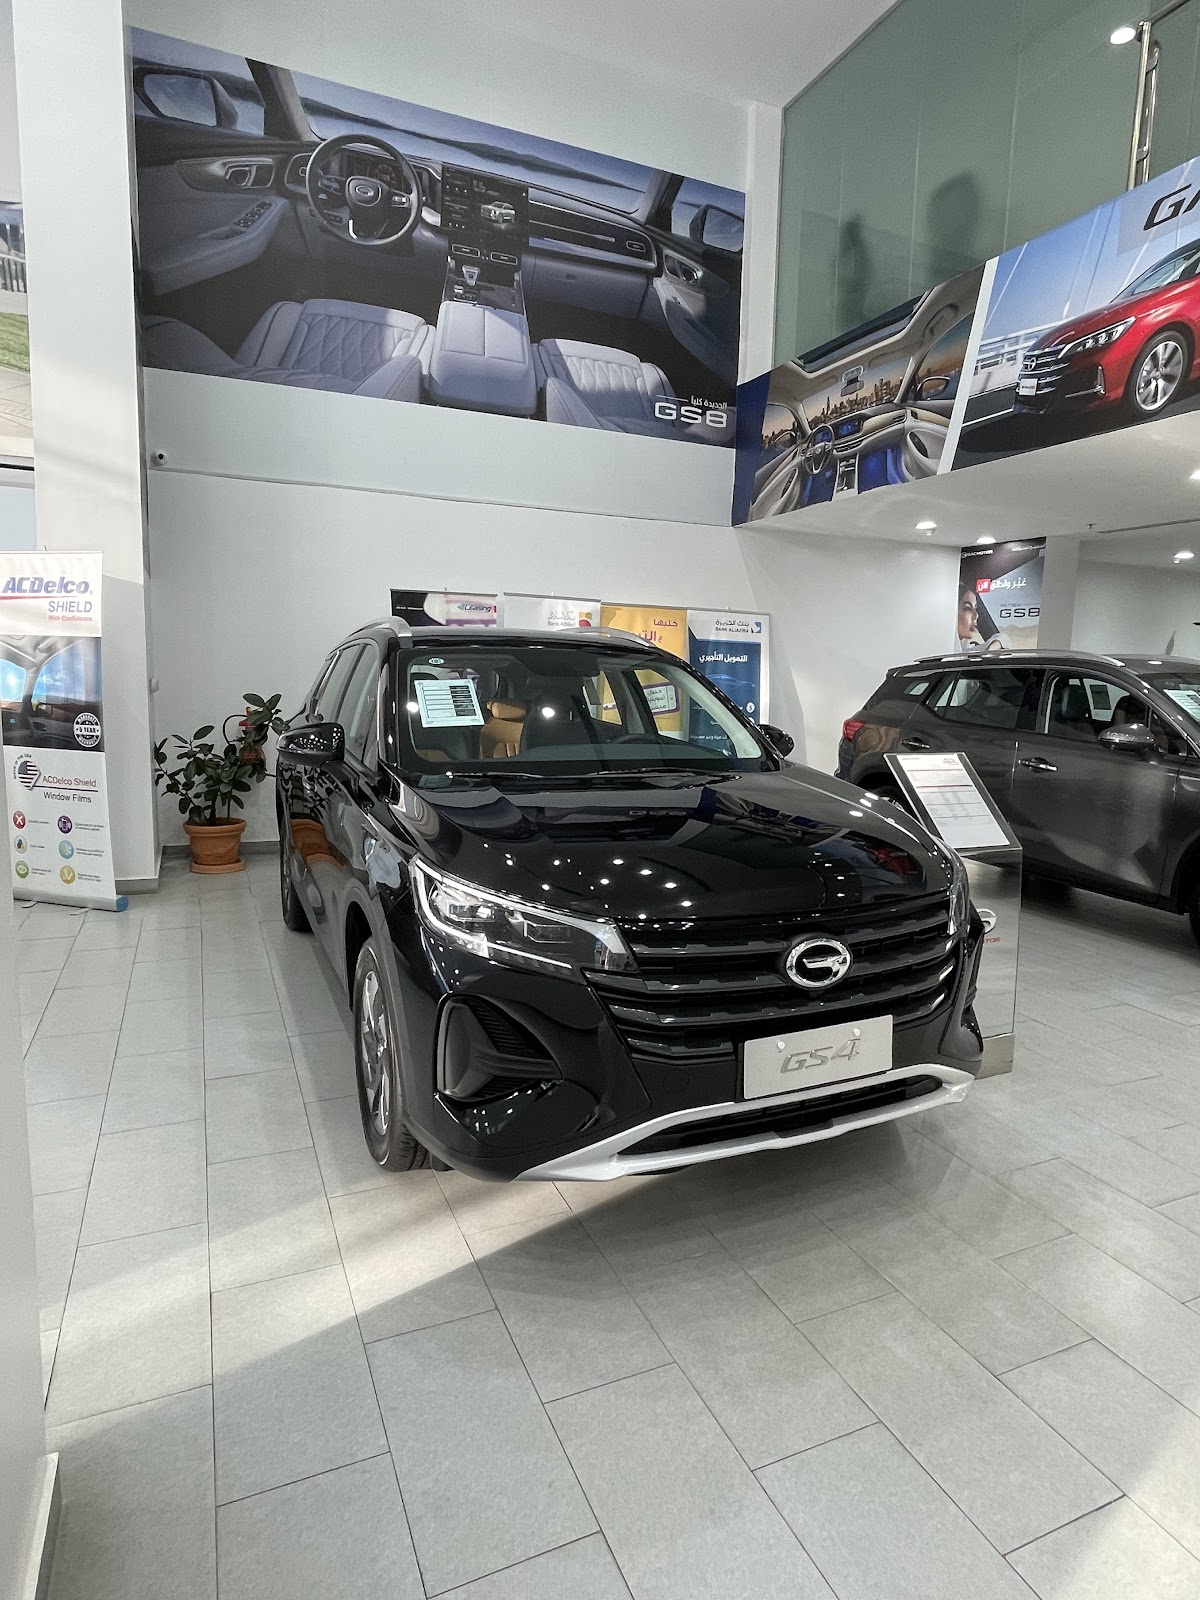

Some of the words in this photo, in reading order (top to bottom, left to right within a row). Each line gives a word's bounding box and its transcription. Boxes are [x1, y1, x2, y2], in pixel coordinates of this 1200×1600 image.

[655, 402, 727, 427] GS8
[1, 576, 90, 594] ACDelco
[48, 600, 93, 613] SHIELD
[1000, 607, 1040, 618] GS8
[737, 620, 750, 628] بنك
[725, 653, 748, 663] التمويل
[42, 775, 73, 786] ACDelco
[74, 777, 97, 788] Shield
[43, 791, 71, 802] Window
[72, 793, 92, 804] Films
[780, 1037, 861, 1074] GS4
